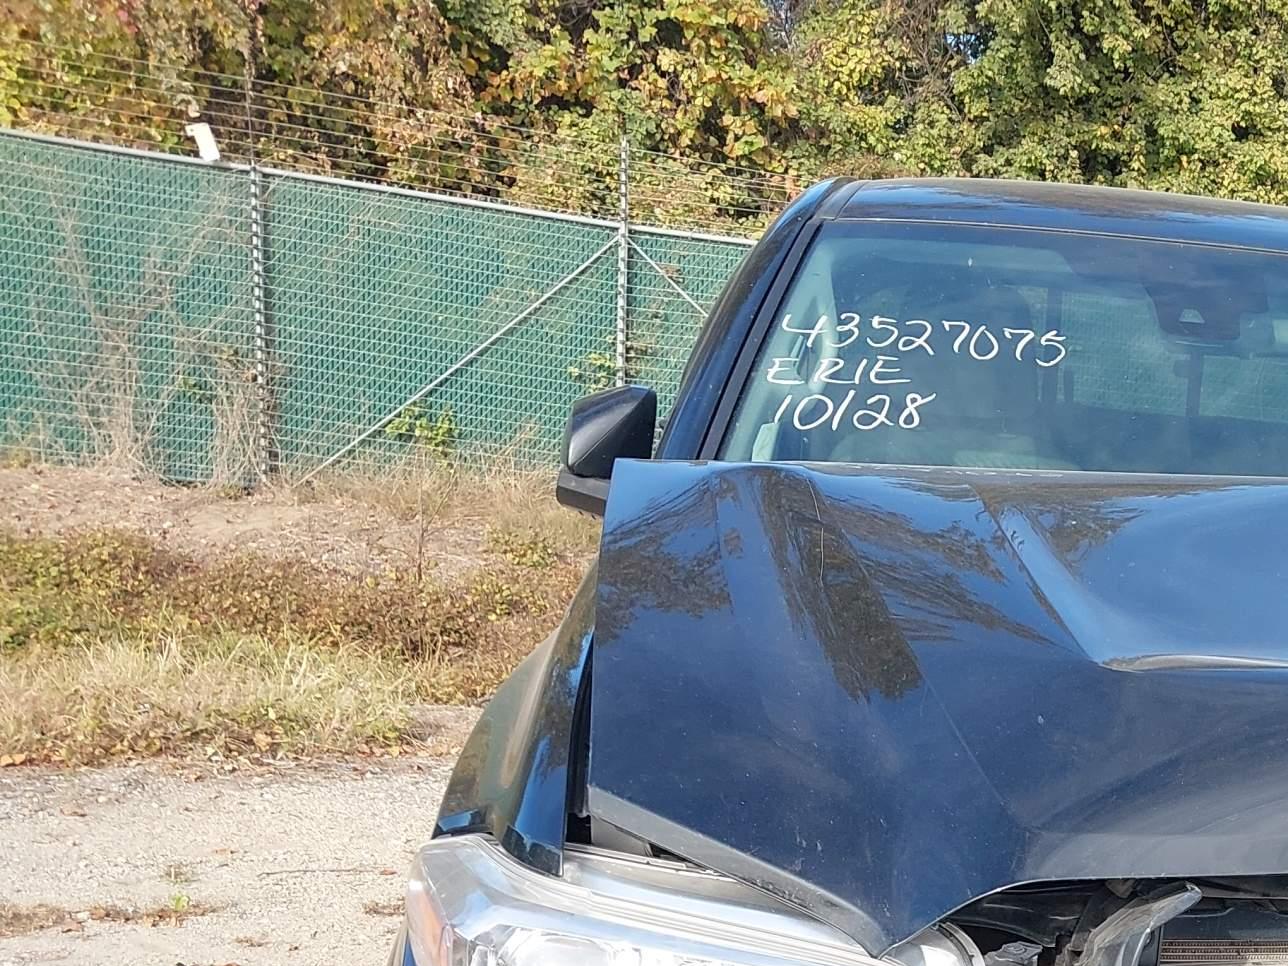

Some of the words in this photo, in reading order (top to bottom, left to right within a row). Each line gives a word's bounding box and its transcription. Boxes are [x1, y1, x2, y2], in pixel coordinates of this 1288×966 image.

[781, 312, 1068, 368] 43527075
[766, 356, 912, 386] ERIE
[773, 389, 937, 432] 10/28
